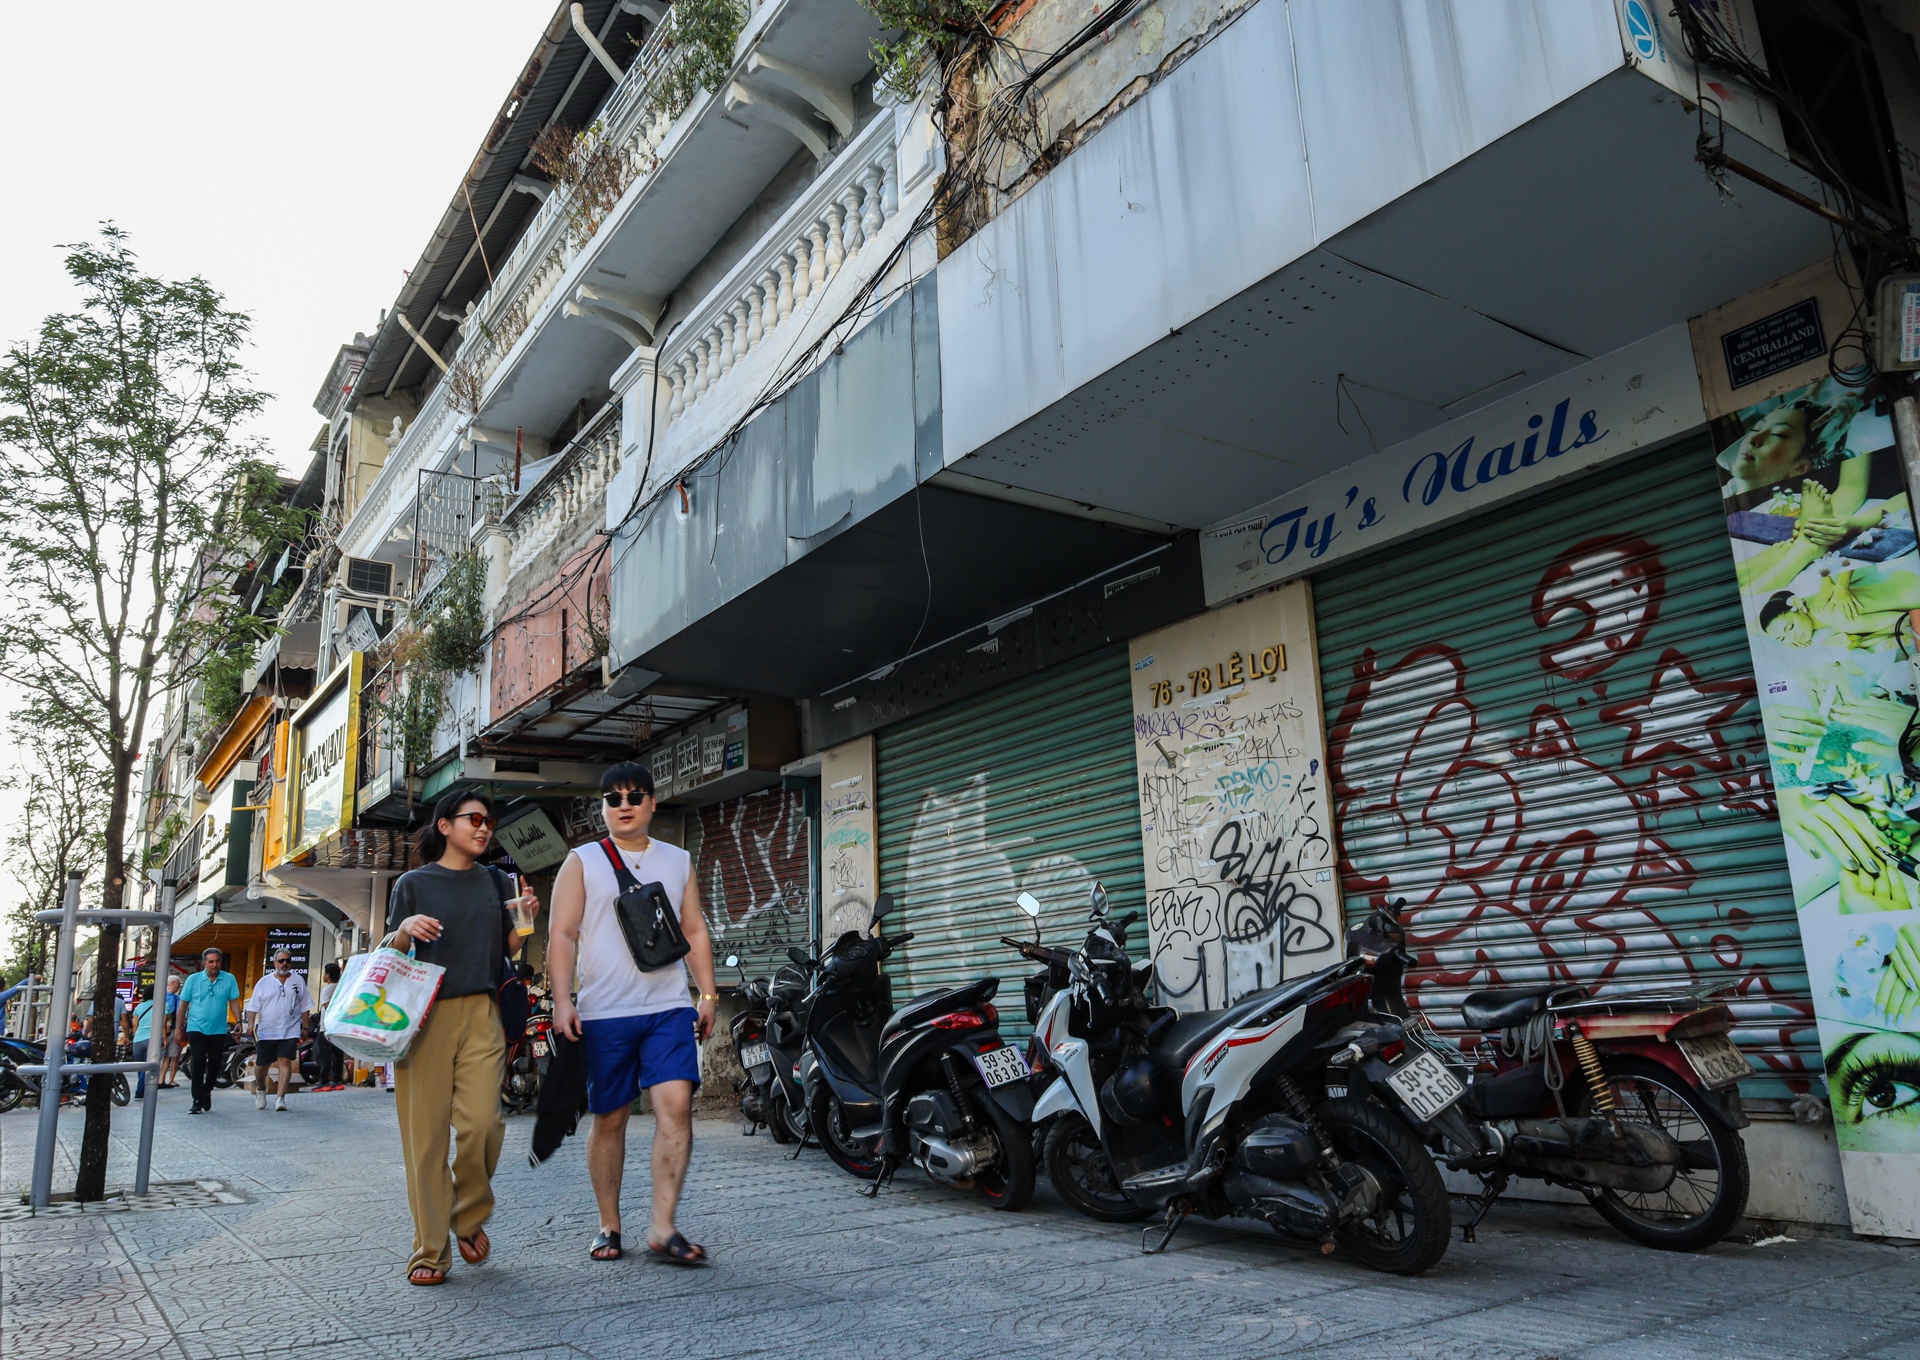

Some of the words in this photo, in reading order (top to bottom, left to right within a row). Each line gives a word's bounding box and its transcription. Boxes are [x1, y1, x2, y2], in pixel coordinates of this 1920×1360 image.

[1732, 325, 1815, 366] CENTRALLAND
[1260, 486, 1386, 565] Ty's
[1403, 397, 1609, 506] Nails
[1150, 680, 1173, 708] 76
[1188, 667, 1212, 696] 78
[1216, 652, 1245, 689] LÊ
[1248, 643, 1287, 682] LỢI
[747, 1051, 770, 1066] 8368
[985, 1061, 1028, 1086] 063.82
[1411, 1073, 1461, 1116] 016.60
